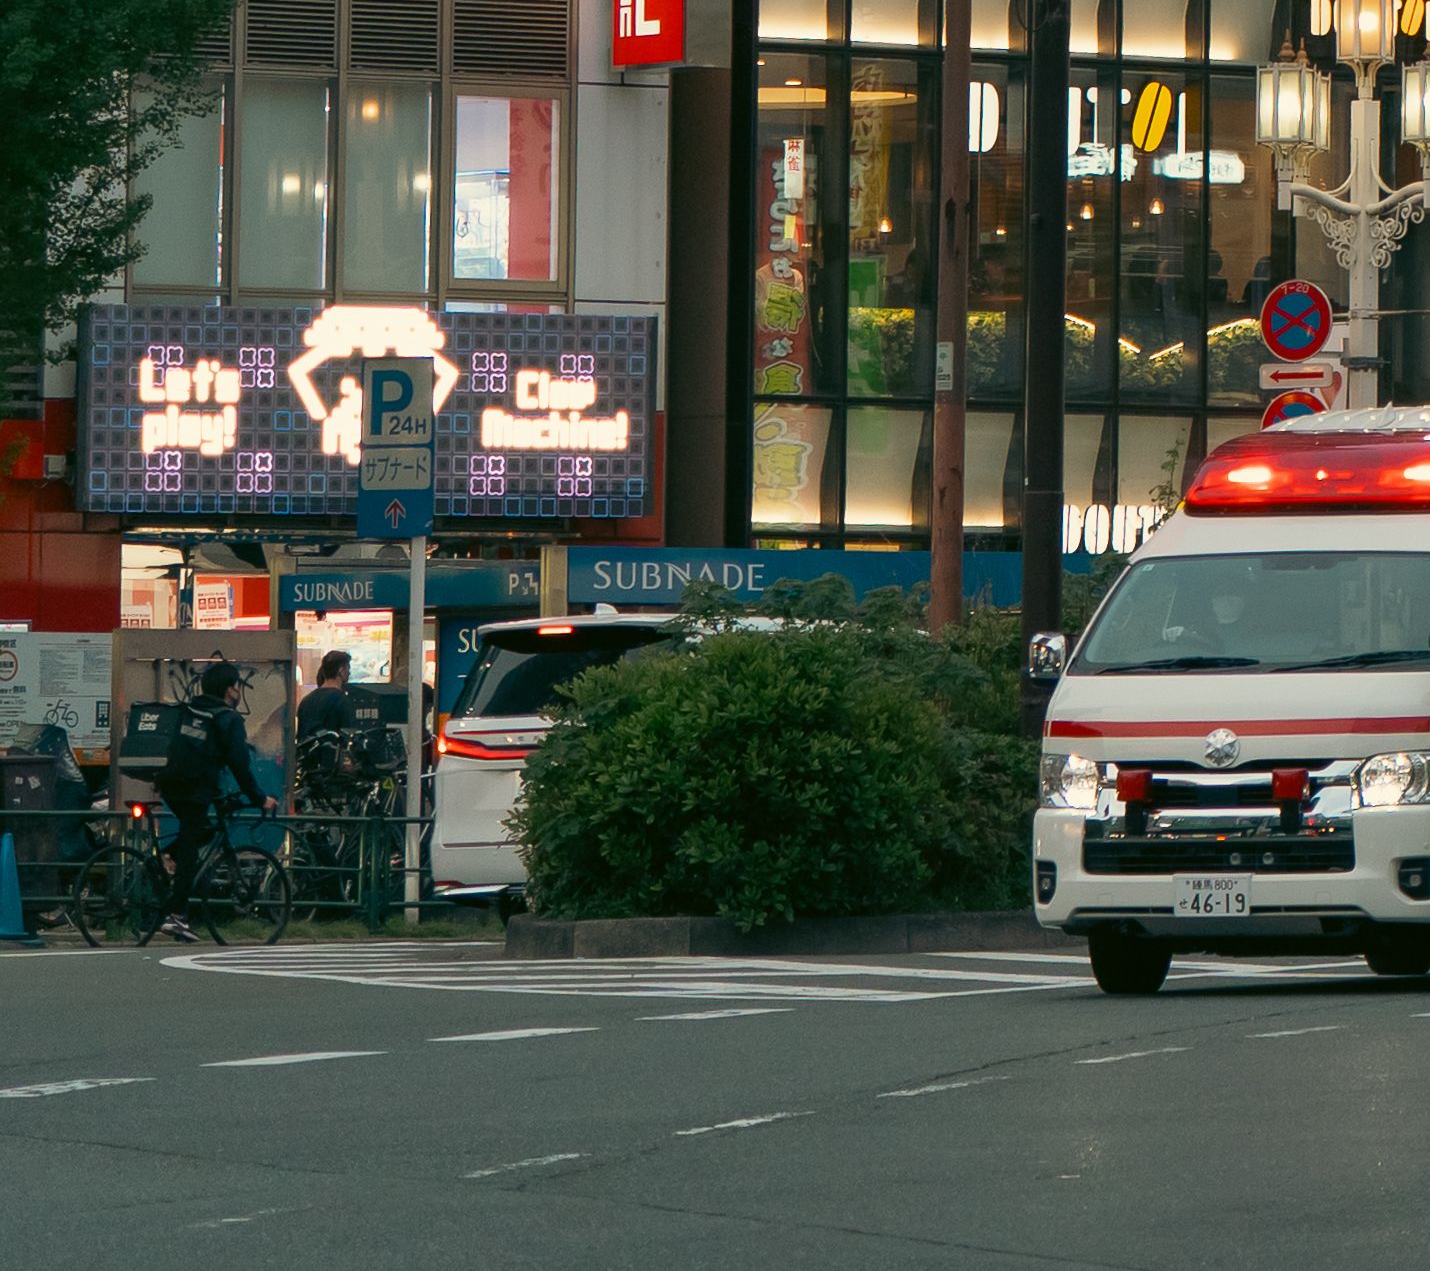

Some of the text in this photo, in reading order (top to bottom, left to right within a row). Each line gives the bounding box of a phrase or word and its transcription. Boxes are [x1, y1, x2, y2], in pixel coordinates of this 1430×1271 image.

[786, 139, 800, 172] 麻雀
[139, 358, 241, 403] Let's
[515, 370, 597, 408] Claw
[372, 371, 413, 439] P
[142, 407, 238, 454] play!
[388, 415, 427, 435] 24H
[481, 408, 627, 451] Machine!
[364, 456, 428, 483] サブナード
[592, 559, 766, 592] SUBNADE
[293, 580, 374, 602] SUBNADE
[138, 721, 158, 731] Eats
[139, 712, 160, 722] Uber
[1215, 880, 1233, 890] 800
[1191, 893, 1245, 914] 46-19
